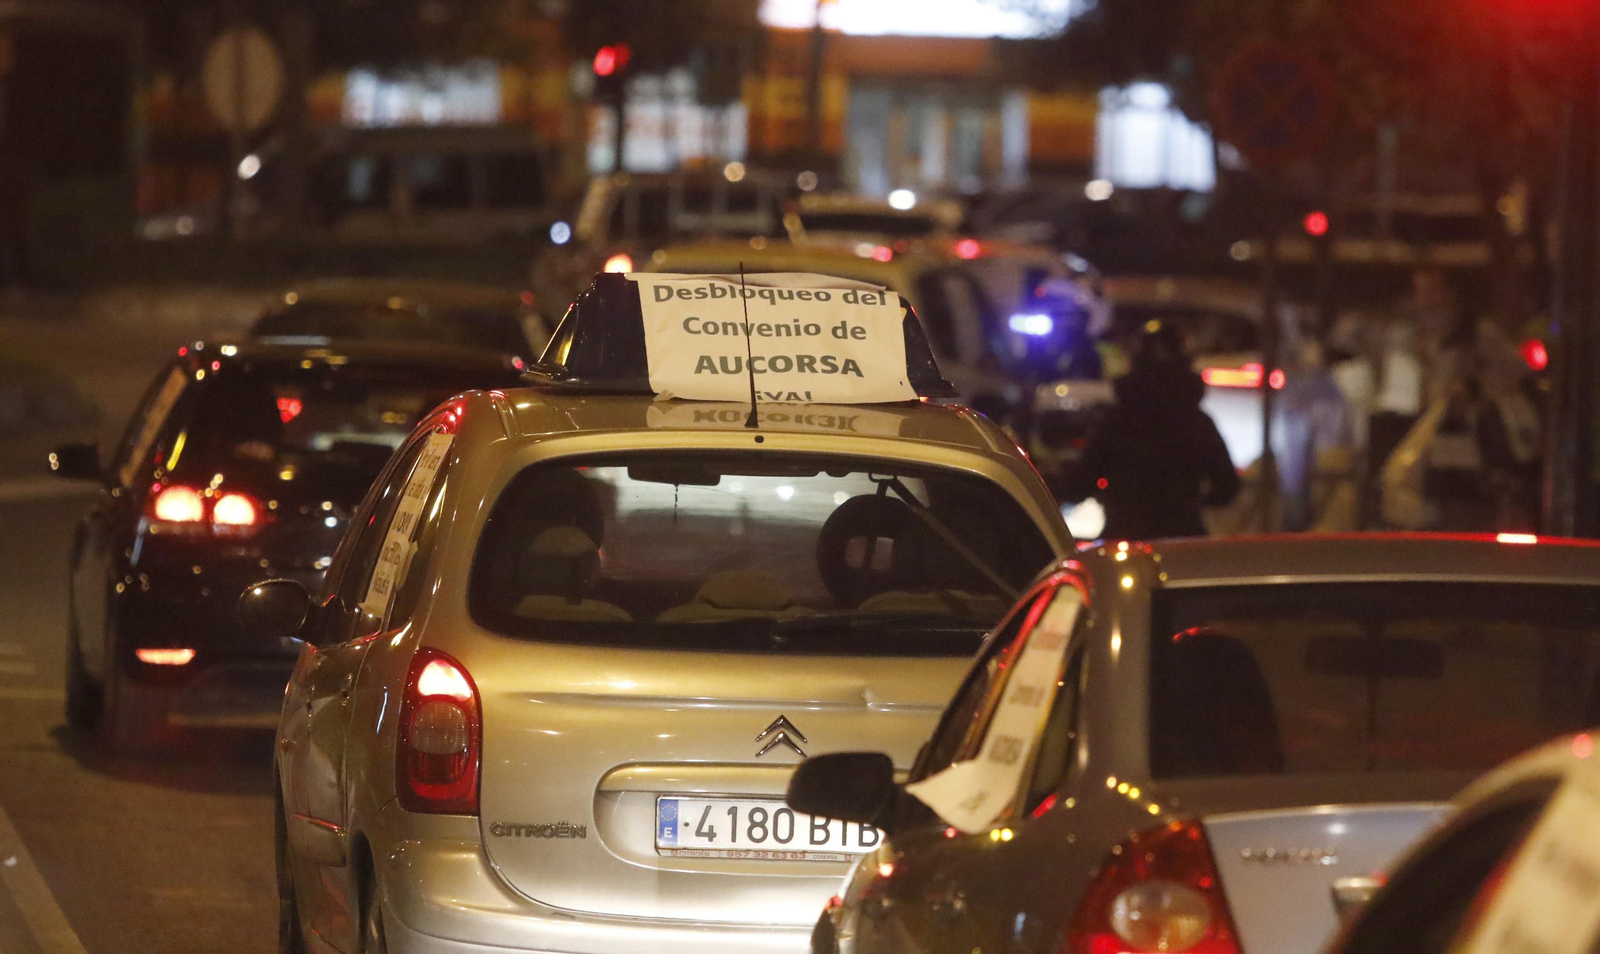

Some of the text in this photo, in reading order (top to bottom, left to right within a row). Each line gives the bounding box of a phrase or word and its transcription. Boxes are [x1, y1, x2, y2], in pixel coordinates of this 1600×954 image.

[653, 282, 887, 306] Desbloqueo del
[682, 316, 867, 341] Convenio de
[694, 354, 865, 378] AUCORSA
[489, 821, 587, 838] CITROËN
[663, 826, 673, 838] E
[694, 804, 795, 844] 4180
